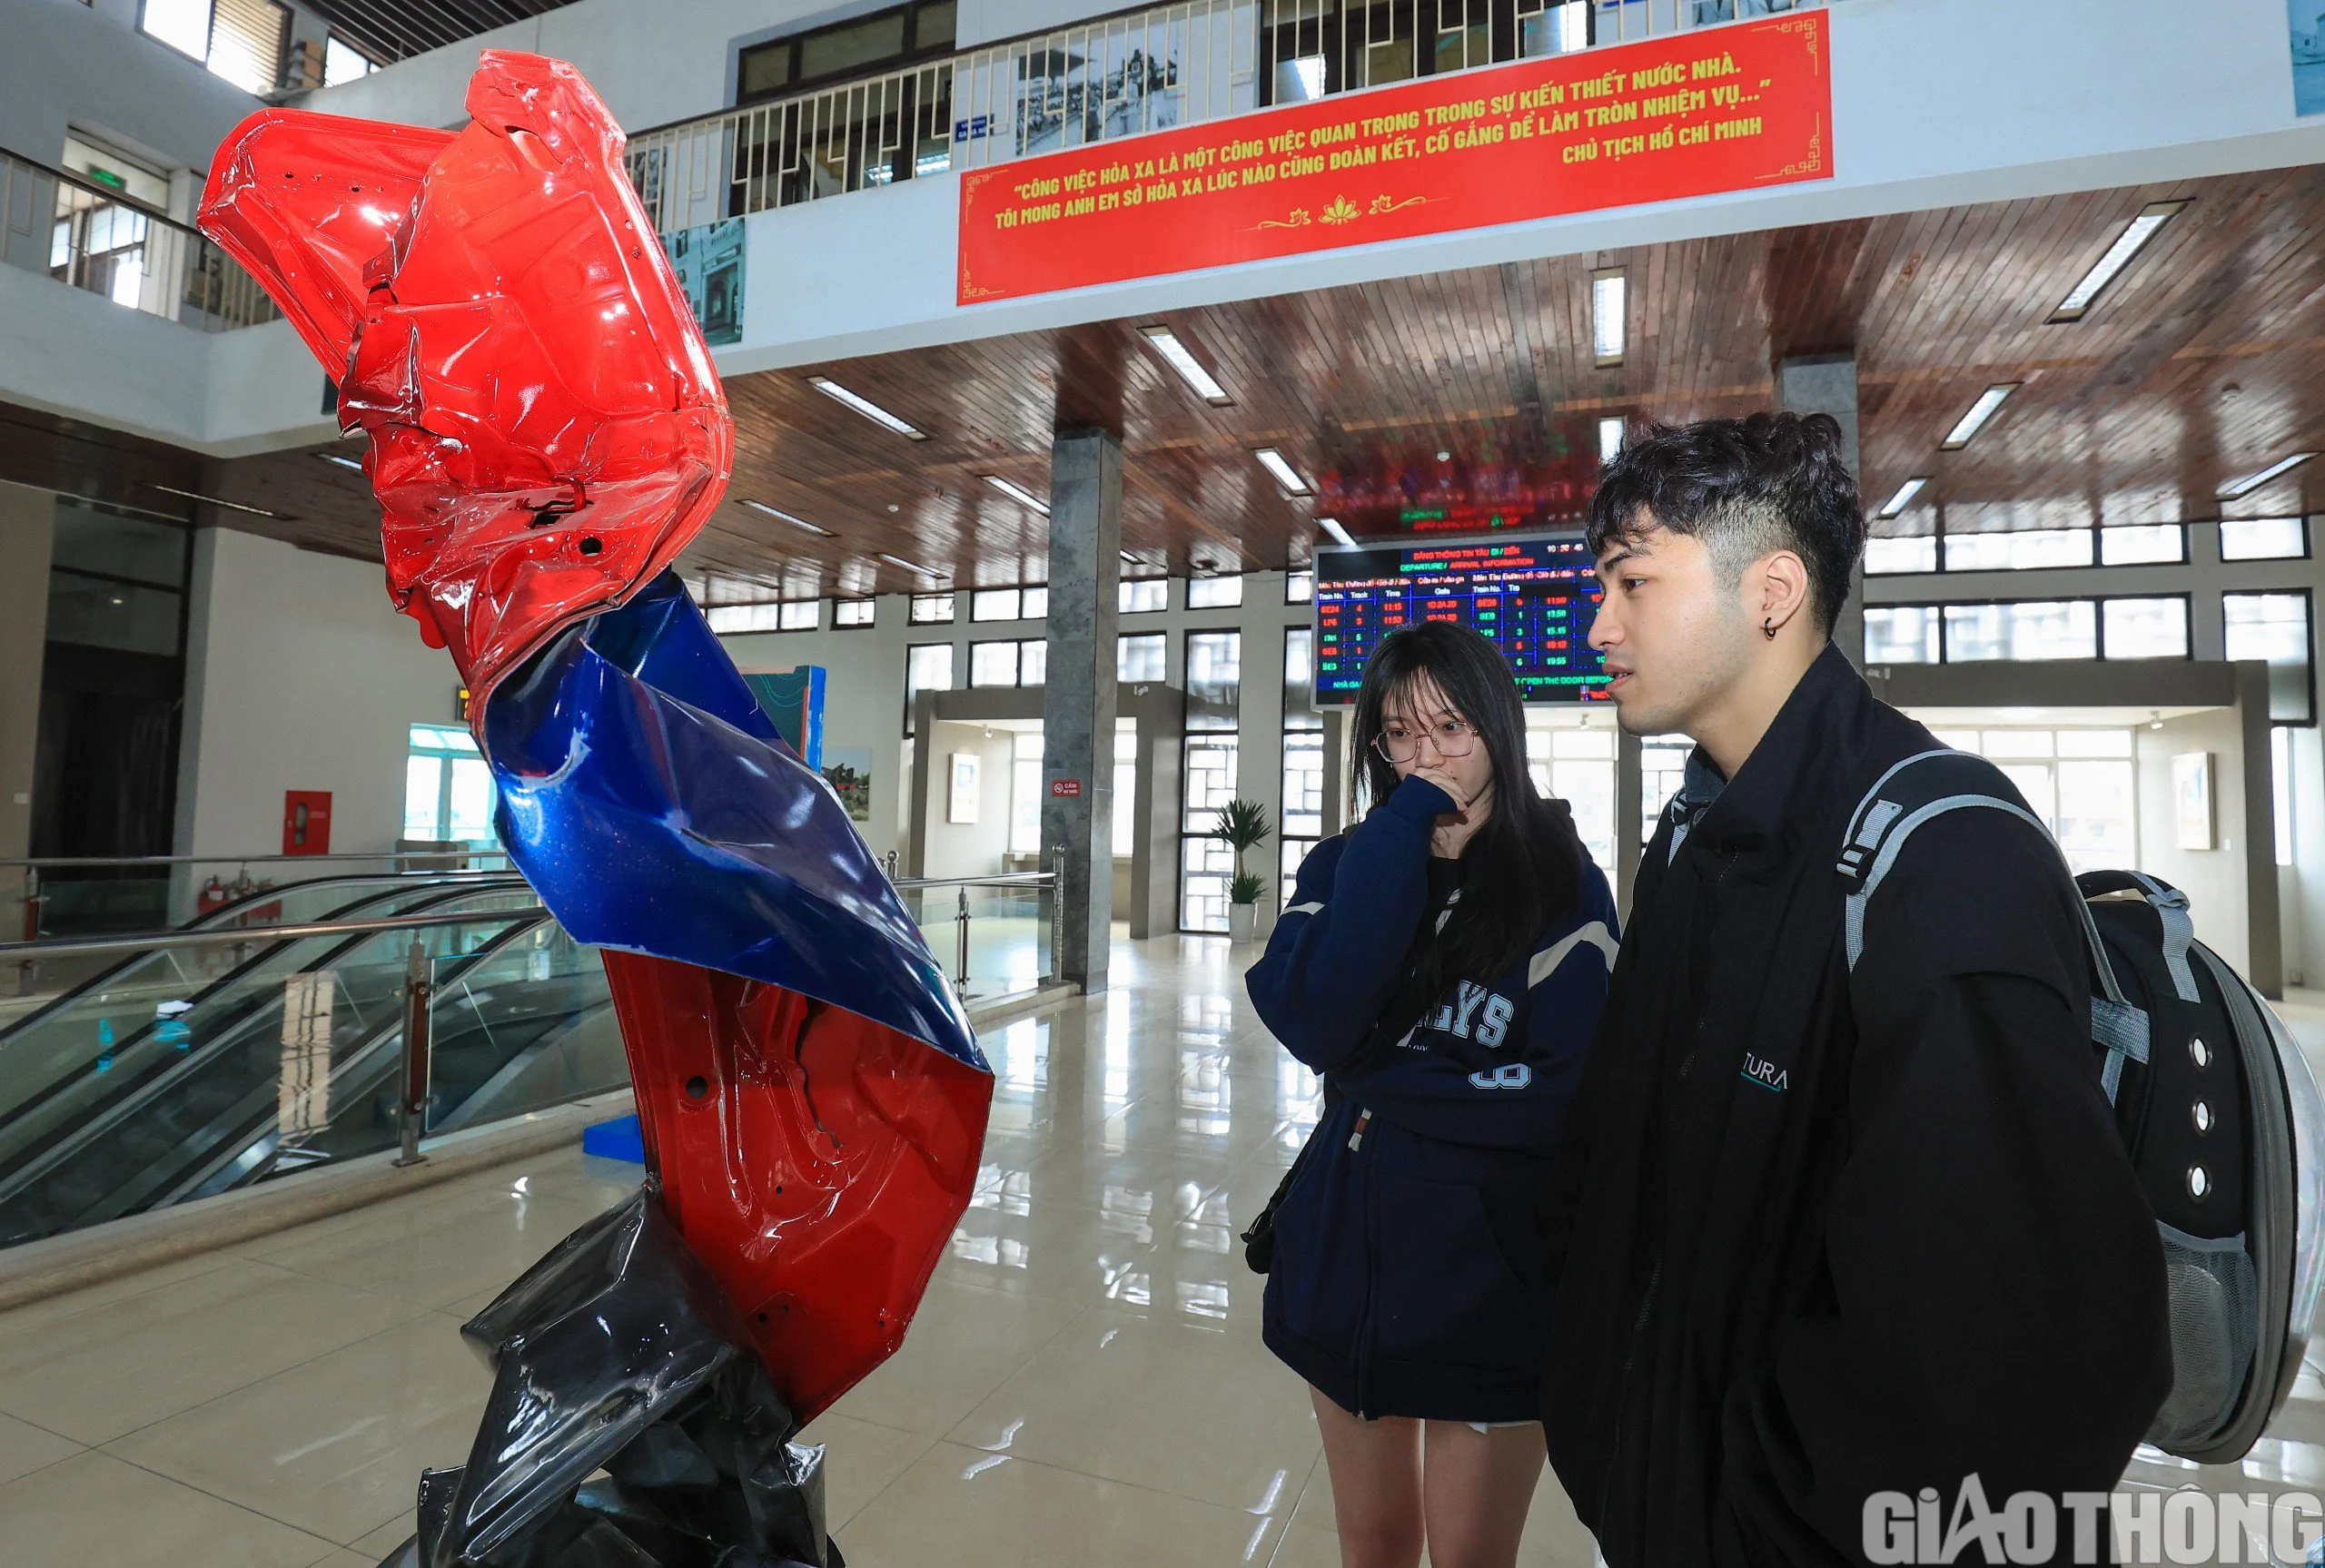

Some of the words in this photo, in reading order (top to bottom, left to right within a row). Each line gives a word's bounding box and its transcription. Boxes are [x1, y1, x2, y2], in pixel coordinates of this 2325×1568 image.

[994, 208, 1019, 230] TÔI
[1021, 203, 1061, 225] MONG
[1064, 194, 1095, 217] ANH
[1099, 191, 1120, 212] EM
[1146, 178, 1178, 202] HỎA
[1182, 177, 1203, 197] XA
[1208, 169, 1239, 192] LÚC
[1242, 163, 1276, 186] NÀO
[1280, 155, 1325, 179] CŨNG
[1330, 144, 1377, 171] ĐOÀN
[1381, 135, 1420, 162] KẾT,
[1425, 127, 1449, 153] CỐ
[1454, 120, 1504, 150] GẮNG
[1509, 114, 1535, 141] ĐỂ
[1539, 111, 1579, 135] LÀM
[1584, 100, 1637, 128] TRÒN
[1643, 88, 1706, 118] NHIỆM
[1064, 169, 1097, 193] VIỆC
[1100, 162, 1130, 185] HỎA
[1133, 160, 1155, 179] XA
[1159, 152, 1180, 174] LÀ
[1183, 147, 1217, 173] MỘT
[1221, 139, 1264, 163] CÔNG
[1269, 130, 1306, 156] VIỆC
[1311, 123, 1356, 149] QUAN
[1361, 111, 1420, 138] TRỌNG
[1425, 99, 1486, 125] TRONG
[1490, 92, 1516, 118] SỰ
[1519, 82, 1565, 110] KIẾN
[1569, 69, 1628, 101] THIẾT
[1632, 62, 1687, 91] NƯỚC
[1692, 51, 1742, 80] NHÀ.
[1562, 138, 1598, 164] CHỦ
[1603, 135, 1645, 162] TỊCH
[1649, 123, 1675, 150] HỒ
[1678, 121, 1710, 146] CHÍ
[1715, 116, 1763, 141] MINH
[1482, 557, 1534, 567] INFORMATION
